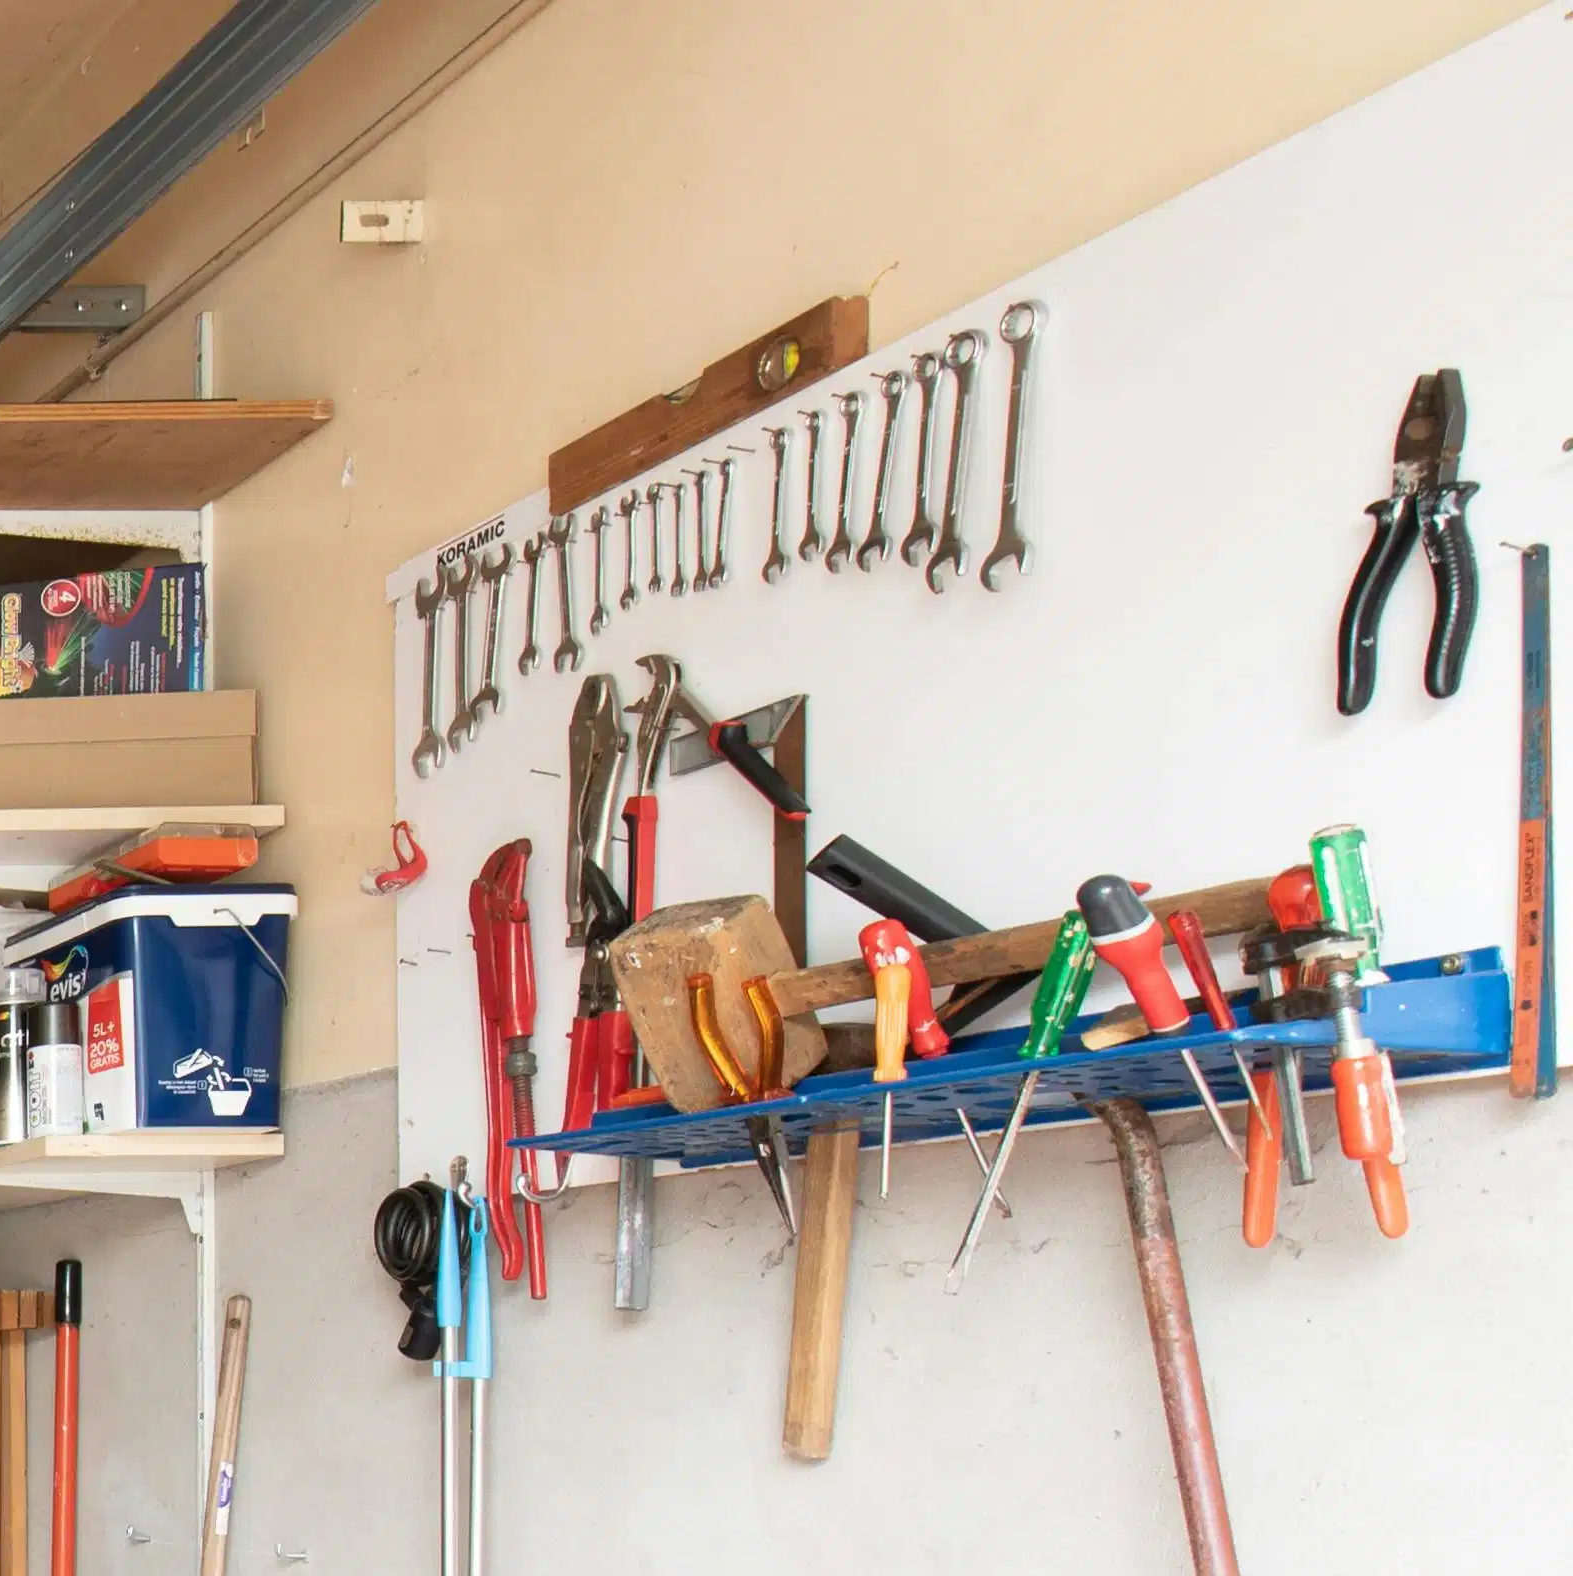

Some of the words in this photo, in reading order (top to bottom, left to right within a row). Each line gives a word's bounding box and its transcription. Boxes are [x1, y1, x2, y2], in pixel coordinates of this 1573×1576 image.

[436, 520, 506, 566] KORAMIC
[59, 591, 77, 603] 4
[1, 594, 21, 636] Glow
[0, 636, 22, 687] Bright
[50, 973, 83, 1003] evis
[89, 1037, 120, 1059] 20%
[89, 1053, 121, 1069] GRATIS
